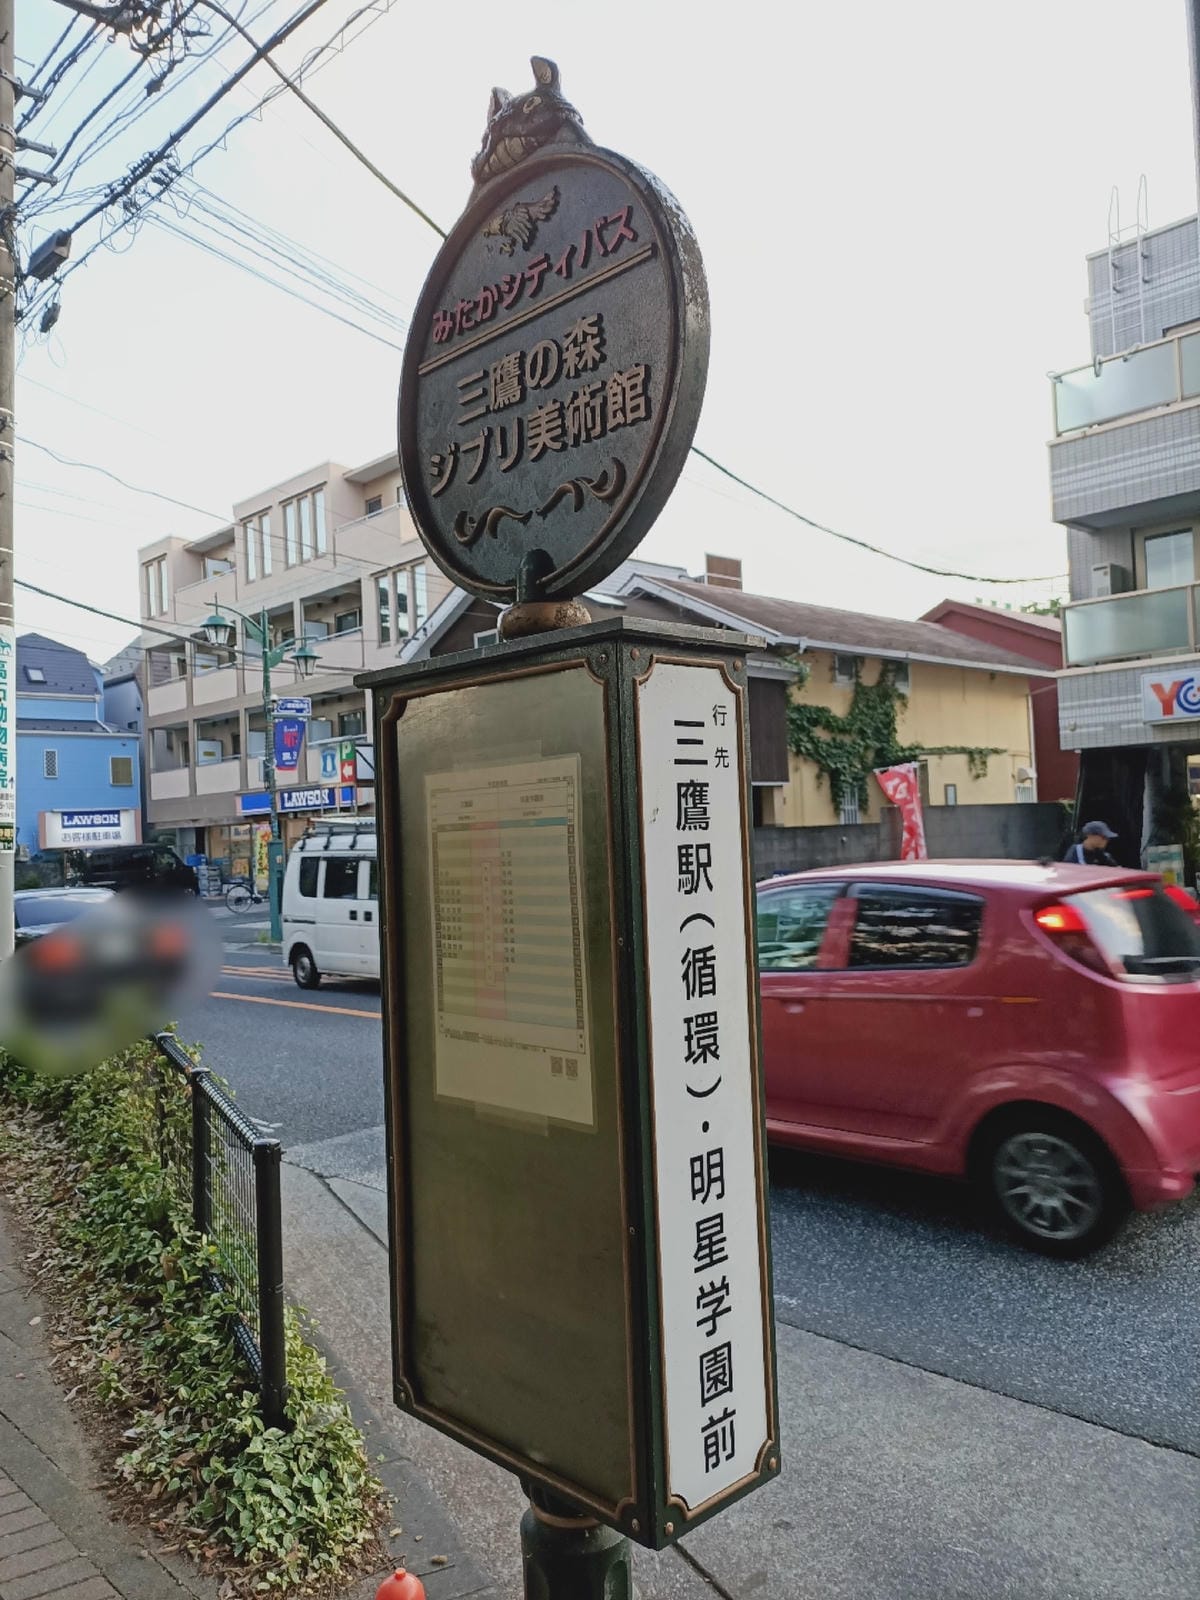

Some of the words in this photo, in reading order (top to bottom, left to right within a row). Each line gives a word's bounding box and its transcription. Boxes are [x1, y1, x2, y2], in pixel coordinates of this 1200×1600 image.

[433, 206, 638, 344] みたかシティバス
[457, 313, 603, 425] 三鷹の森
[430, 363, 651, 497] ジブリ美術館
[711, 703, 730, 769] 行先
[62, 813, 119, 826] LAWSON
[283, 788, 330, 808] LAWSON
